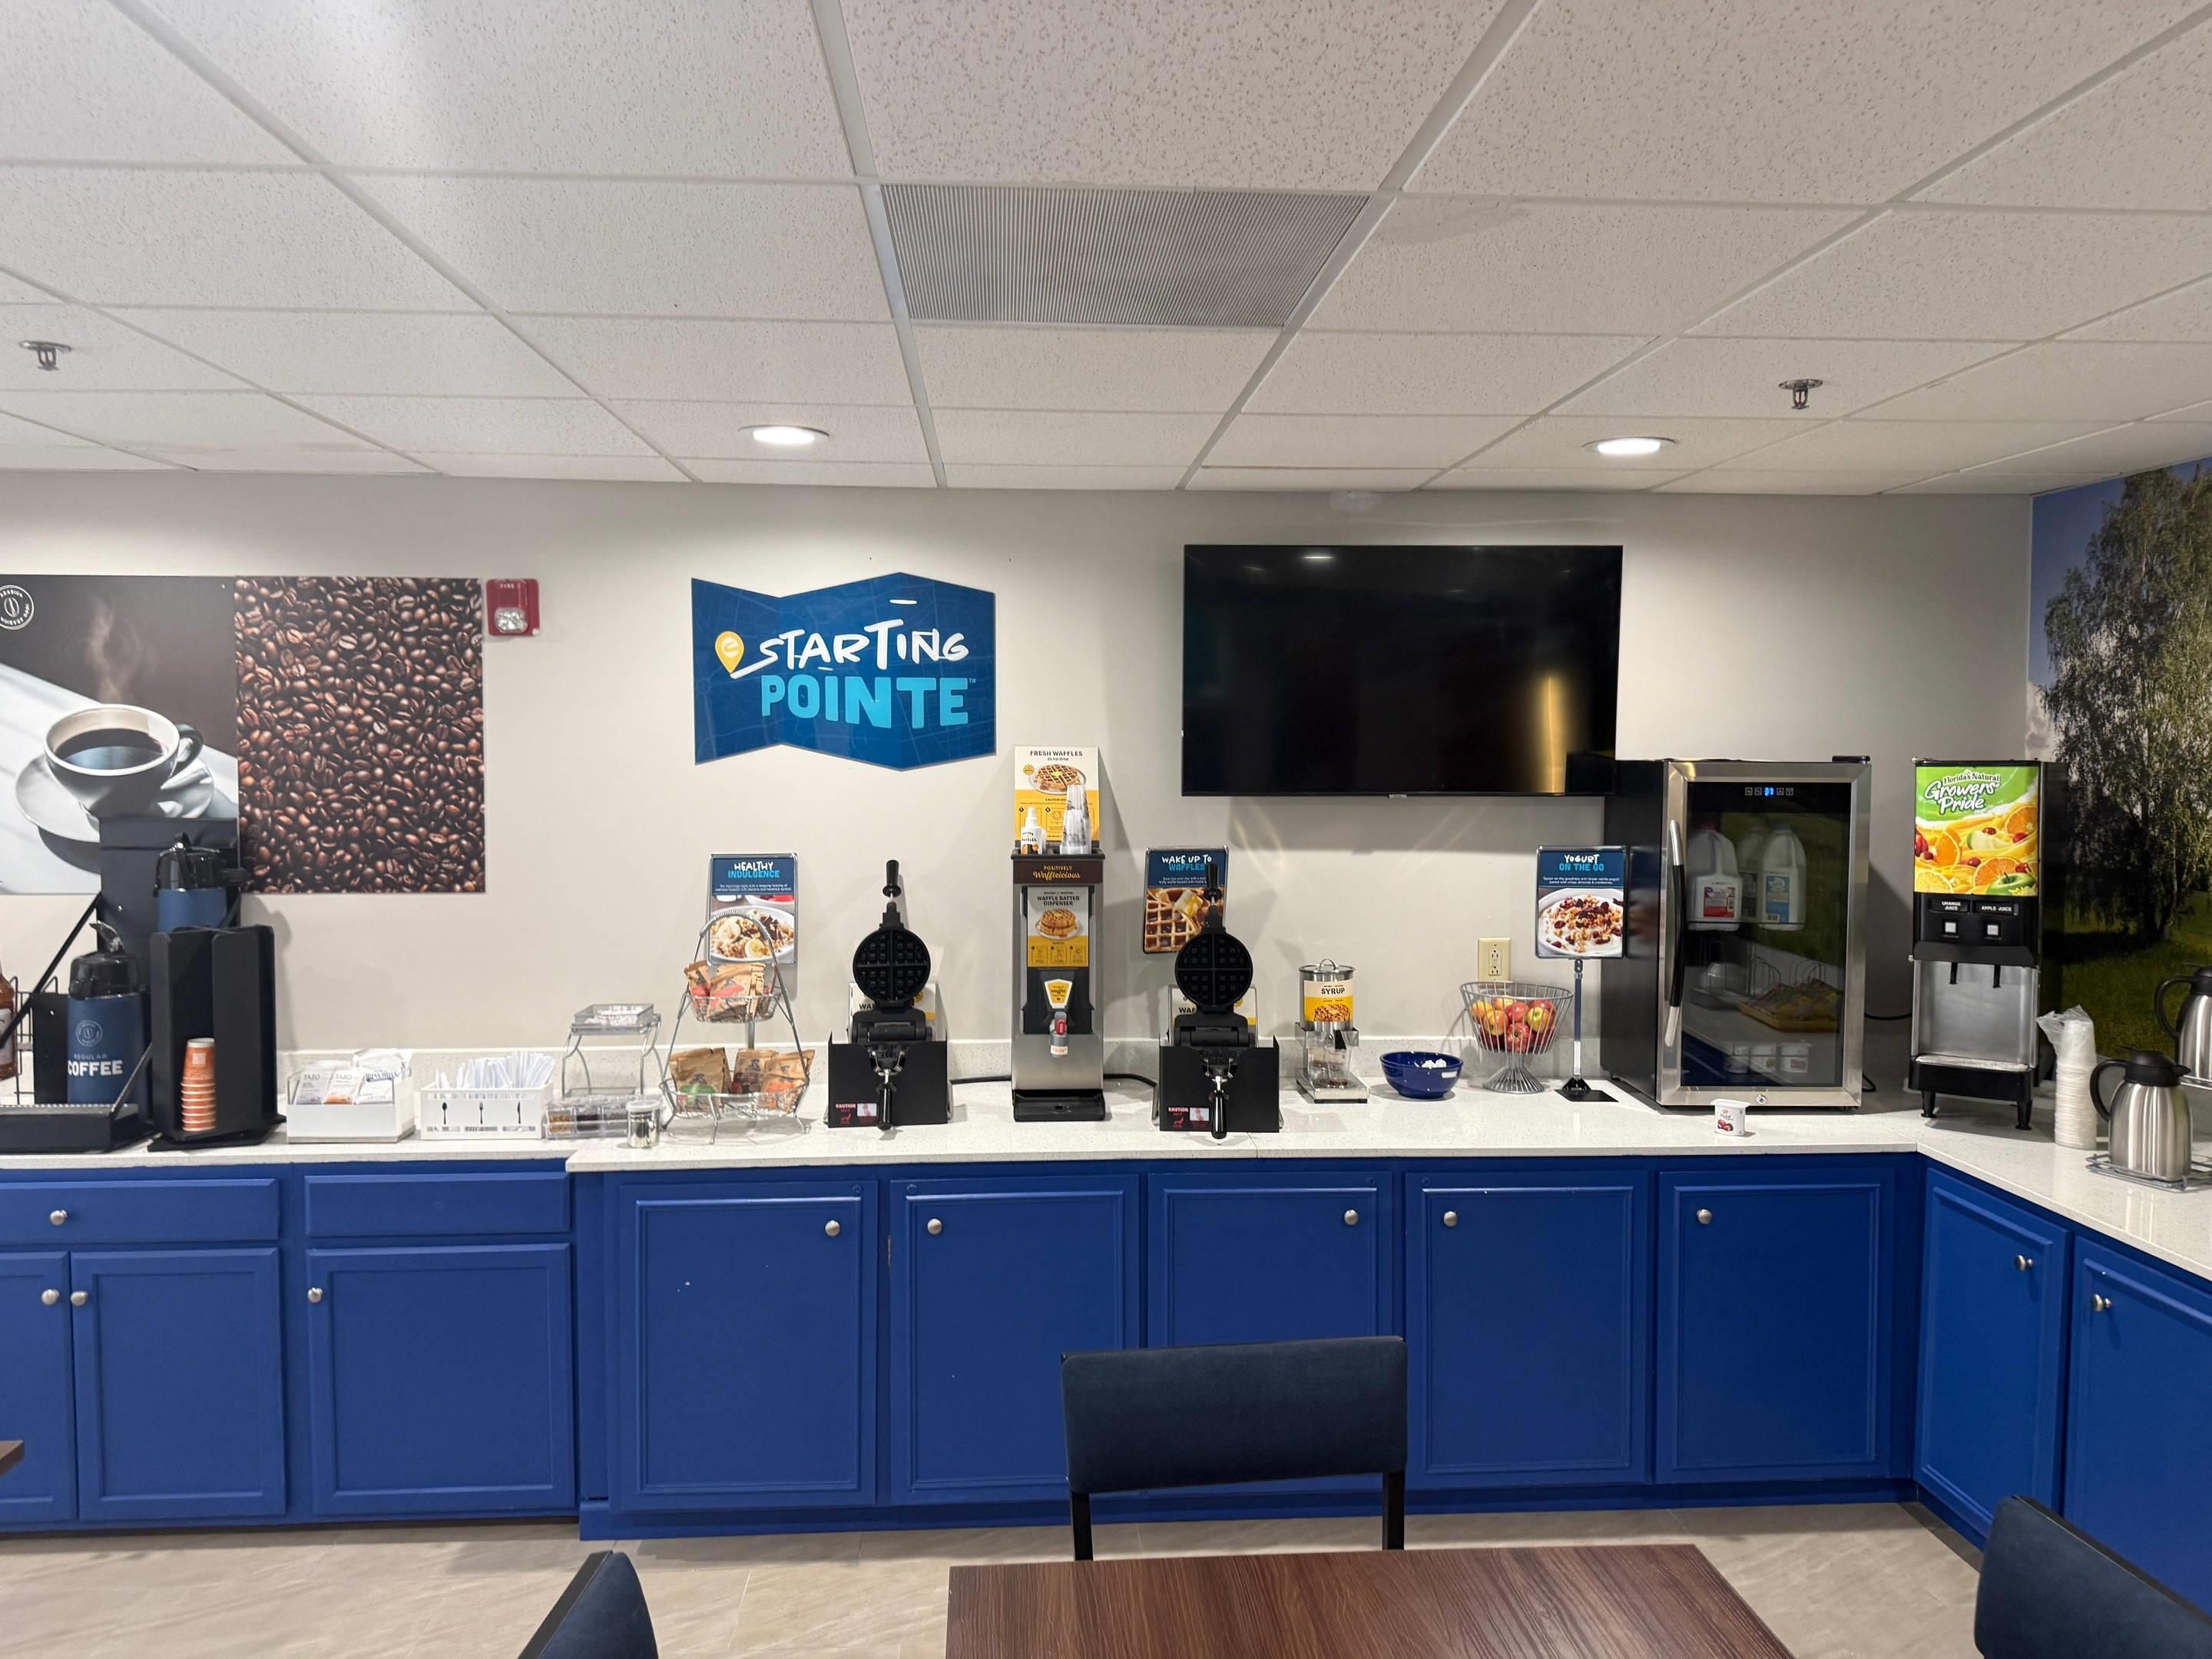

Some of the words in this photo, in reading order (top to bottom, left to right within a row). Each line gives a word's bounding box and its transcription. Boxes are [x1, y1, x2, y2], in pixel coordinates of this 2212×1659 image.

[730, 618, 969, 679] STARTING
[761, 674, 969, 729] POINTE
[1972, 773, 2000, 782] Natural
[1937, 793, 1985, 814] Pride
[734, 860, 773, 871] HEALTHY
[1161, 855, 1186, 865] WAKE
[1188, 855, 1200, 863] UP
[1168, 863, 1205, 872] WAFFLES
[728, 869, 780, 879] INDULGENCE
[68, 1059, 124, 1077] COFFEE
